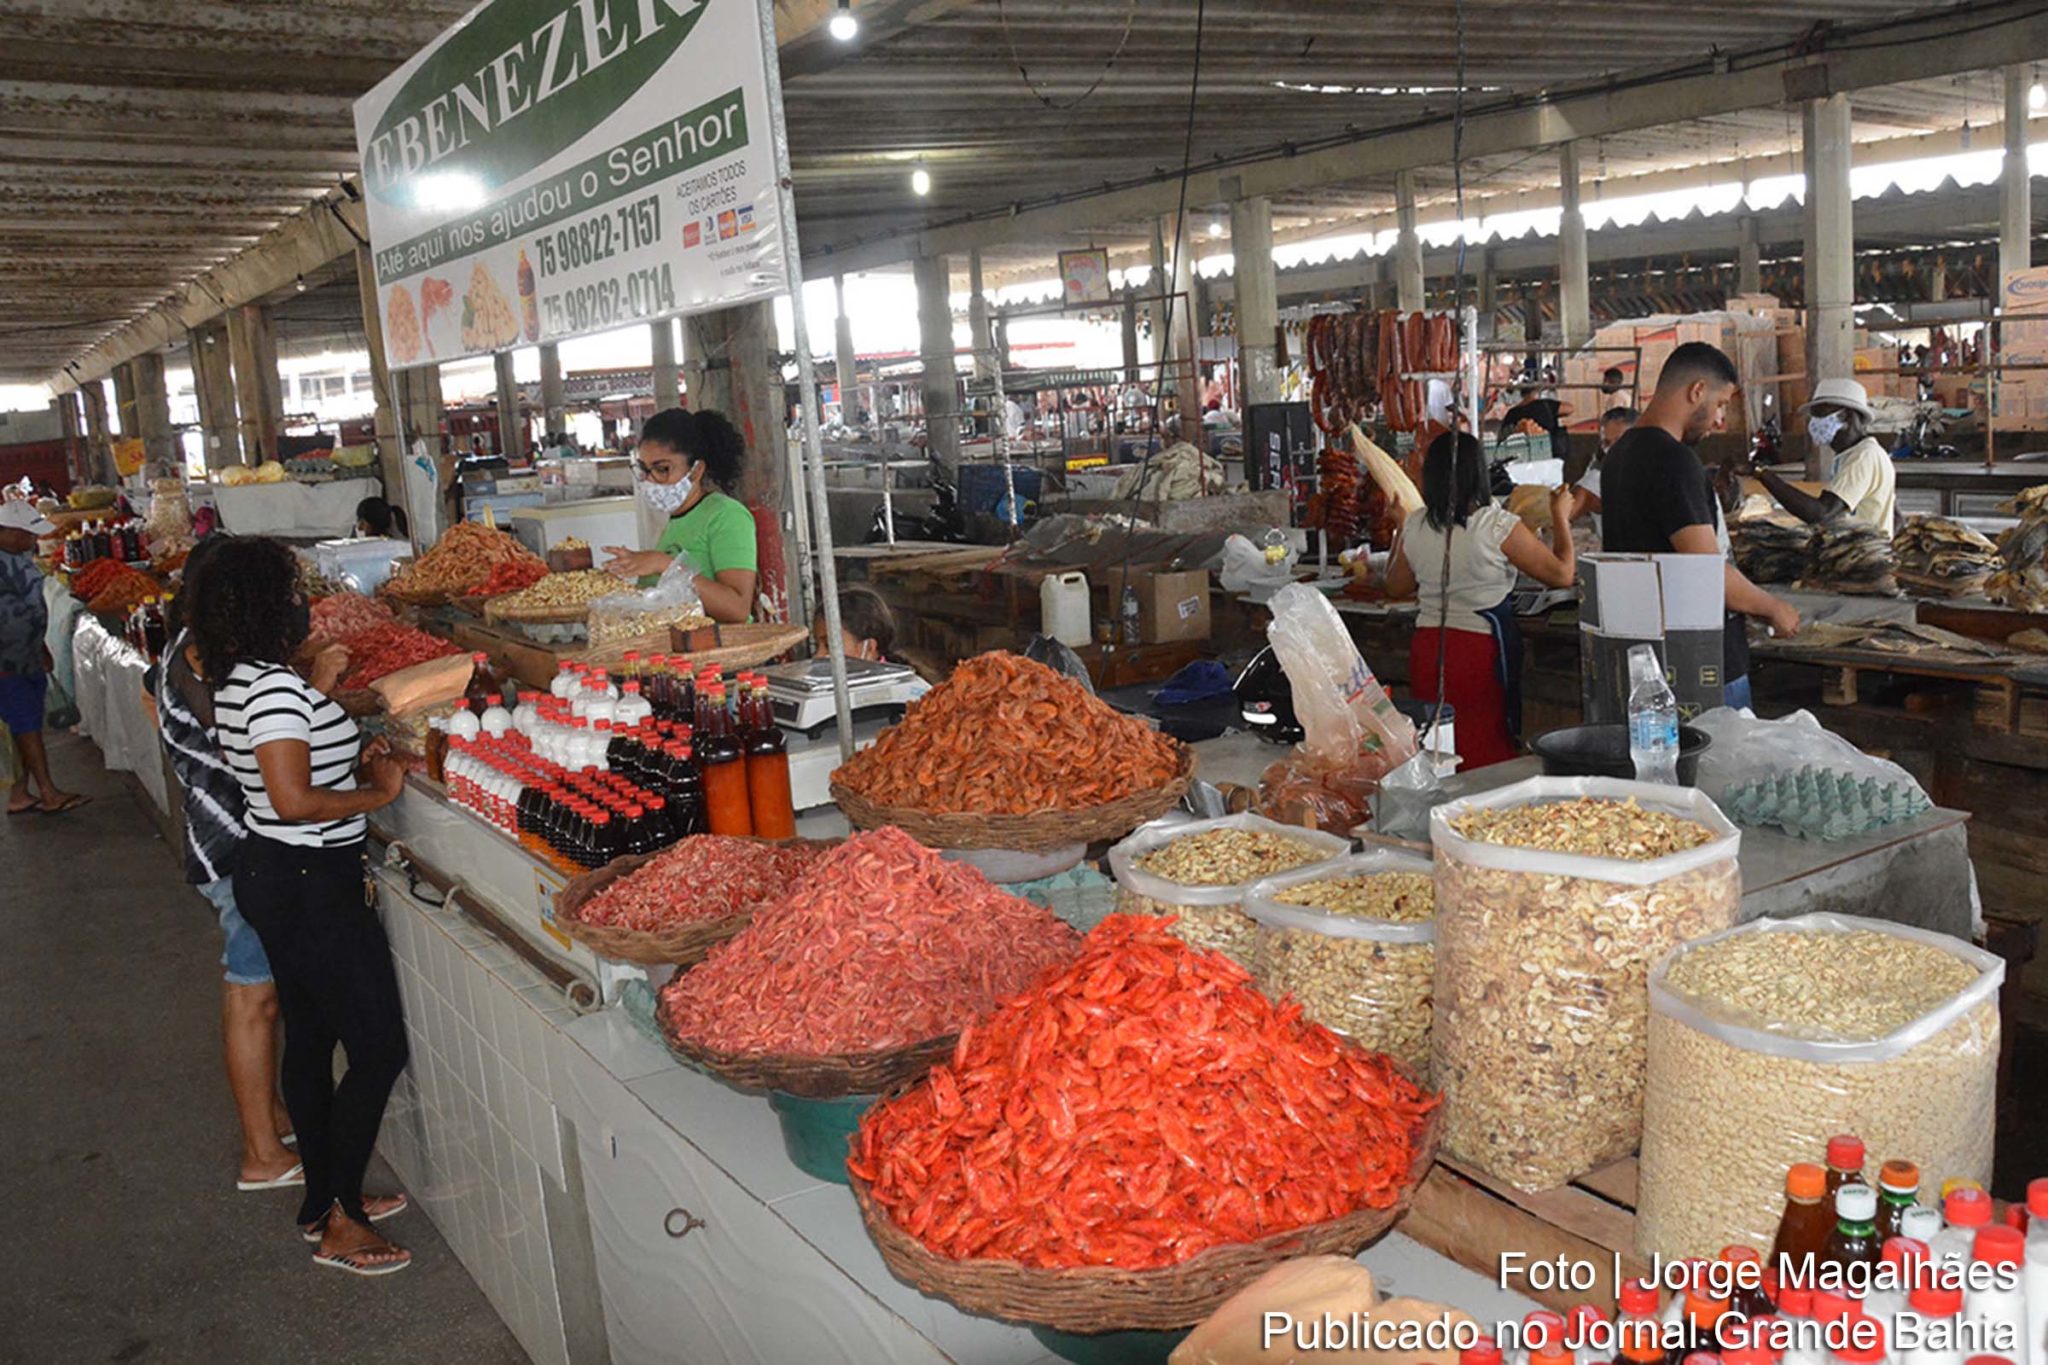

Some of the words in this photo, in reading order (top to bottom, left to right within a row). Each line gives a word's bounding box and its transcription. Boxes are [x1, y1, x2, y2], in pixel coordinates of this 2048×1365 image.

[379, 247, 405, 279] Até
[408, 228, 444, 268] aqui
[450, 219, 486, 252] nos
[491, 180, 572, 239] ajudou
[580, 170, 598, 198] o
[608, 103, 739, 187] Senhor
[676, 171, 718, 198] ACEITAMOS
[718, 160, 747, 182] TODOS
[688, 199, 700, 216] OS
[535, 235, 556, 278] 75
[557, 194, 661, 272] 98822-7157
[565, 262, 676, 331] 98262-0714
